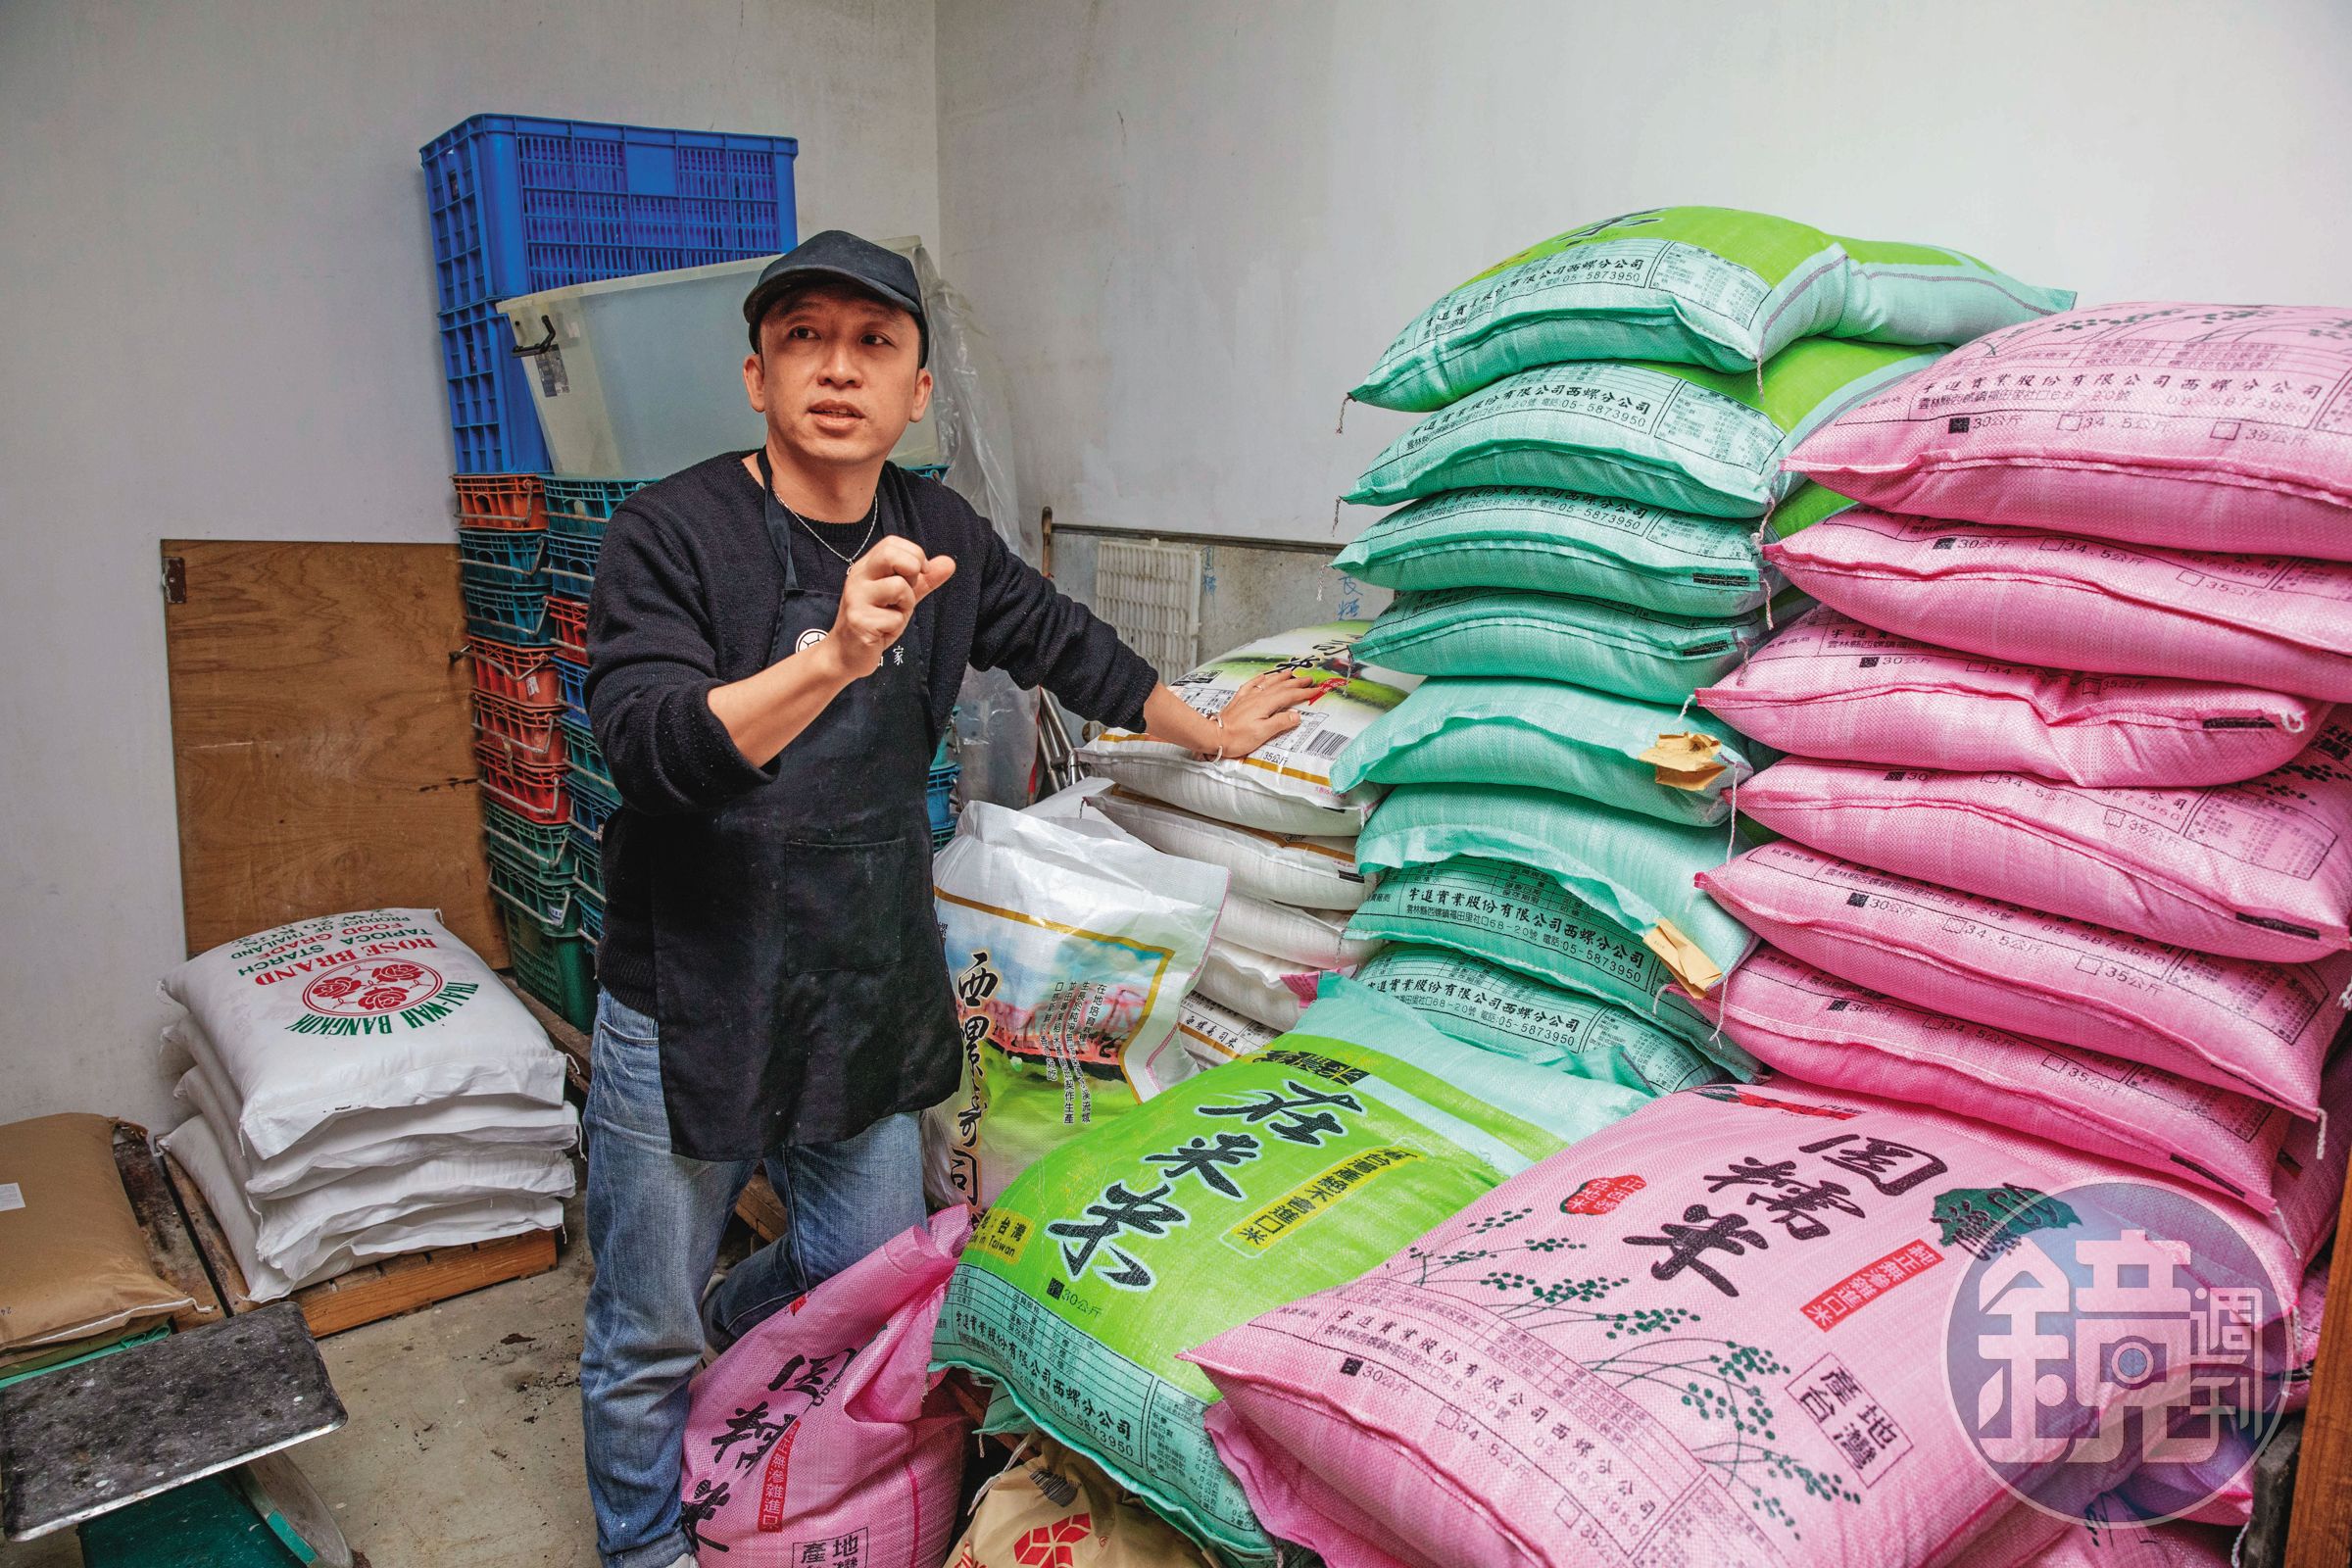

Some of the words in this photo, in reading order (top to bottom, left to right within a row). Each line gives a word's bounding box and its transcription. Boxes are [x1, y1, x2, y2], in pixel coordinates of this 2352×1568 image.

[342, 915, 411, 928] PRODUCE
[1869, 899, 1919, 917] 30公斤
[316, 924, 334, 933] OF
[340, 928, 433, 946] TAPIOCA
[342, 922, 405, 936] FOOD
[231, 931, 305, 959] THAILAND
[256, 932, 332, 959] GRADE
[367, 938, 438, 957] ROSE
[238, 944, 325, 977] STARCH
[255, 951, 357, 986] BRAND
[2103, 966, 2166, 996] 35公斤
[400, 981, 479, 1029] THAI-WAH
[284, 1013, 394, 1036] BANGKOK
[949, 952, 999, 1223] 西螺壽司
[989, 1235, 1016, 1257] Taiwan
[1061, 1288, 1102, 1318] 30公斤
[801, 1534, 859, 1565] 產地
